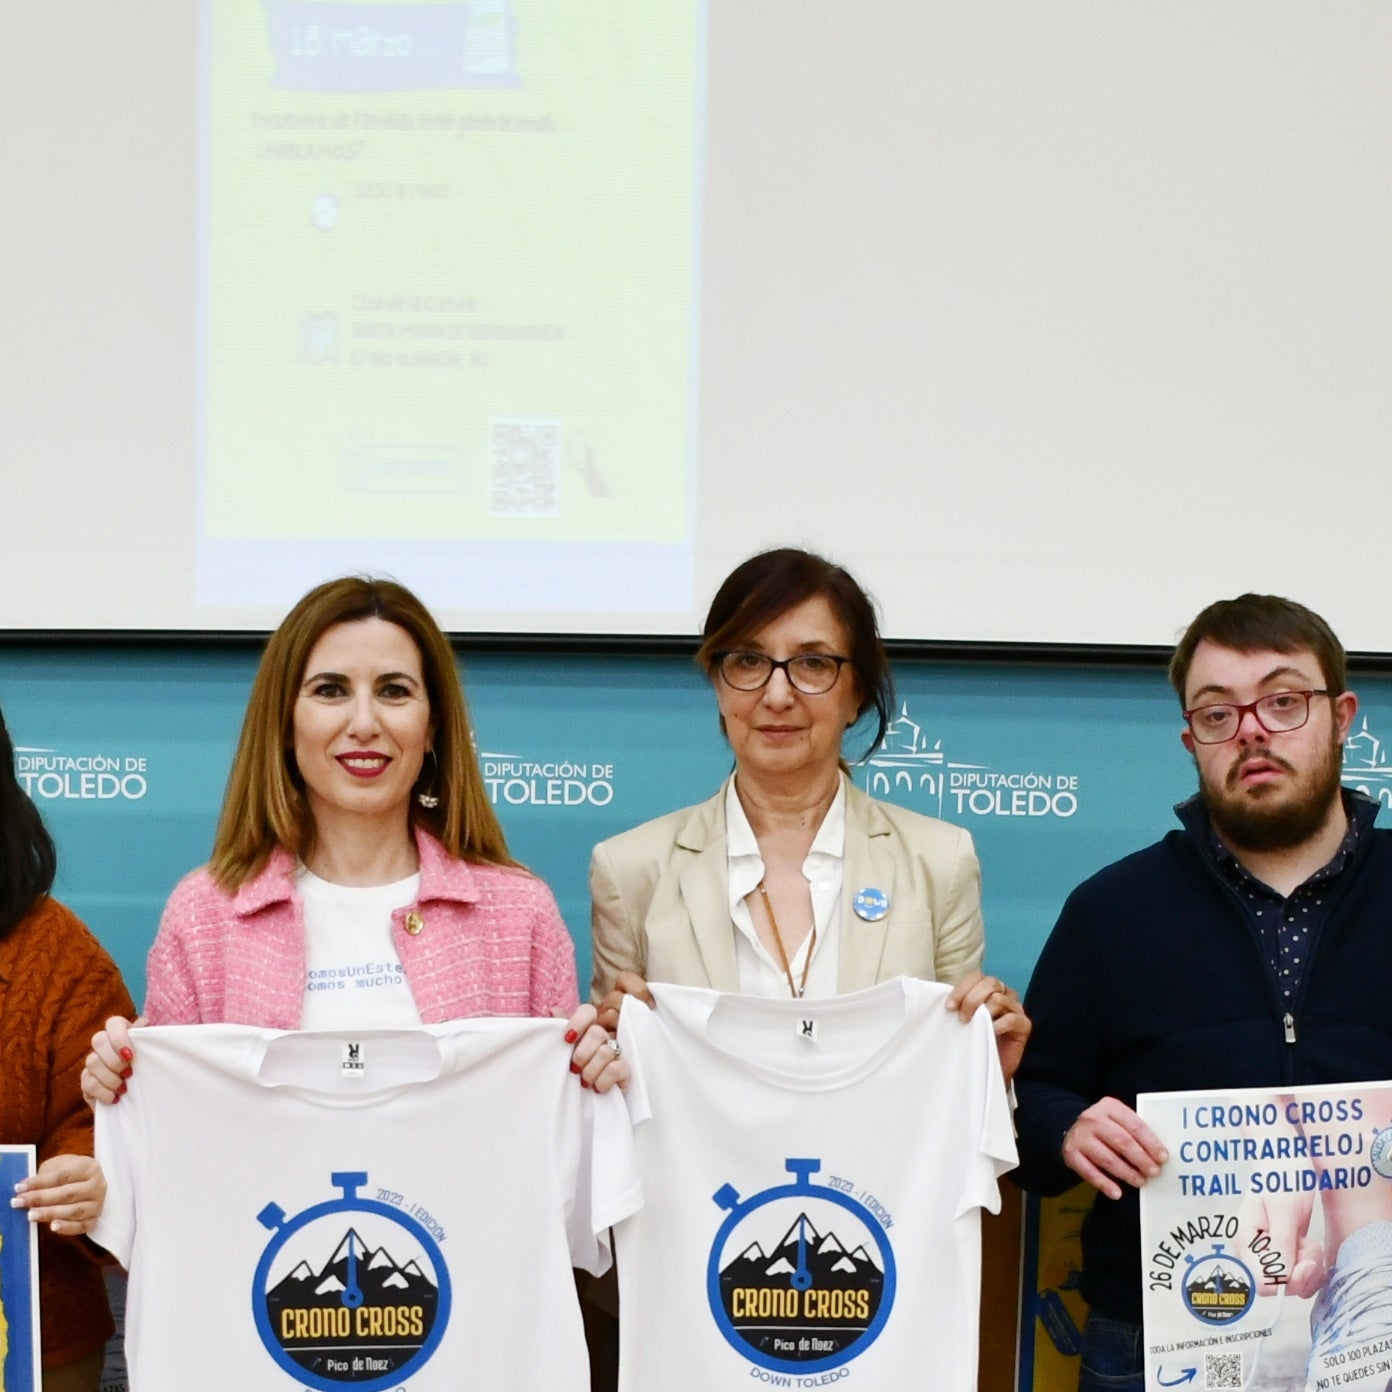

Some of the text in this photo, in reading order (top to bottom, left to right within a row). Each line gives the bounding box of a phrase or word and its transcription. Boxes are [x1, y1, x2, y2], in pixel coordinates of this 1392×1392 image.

[18, 754, 147, 772] DIPUTACIÓN DE
[484, 761, 613, 778] DIPUTACIÓN DE
[18, 772, 147, 799] TOLEDO
[484, 779, 614, 806] TOLEDO
[950, 772, 1078, 790] DIPUTACIÓN DE
[950, 789, 1078, 817] TOLEDO
[307, 963, 406, 979] omosUnEste
[306, 981, 345, 991] omos
[1183, 1098, 1363, 1129] I CRONO CROSS
[1180, 1133, 1363, 1163] CONTRARRELOJ
[828, 1176, 855, 1193] 2023
[1178, 1166, 1371, 1196] TRAIL SOLIDARIO
[376, 1188, 404, 1205] 2023
[1149, 1214, 1239, 1291] 26 DE MARZO
[1248, 1228, 1288, 1286] 10:00H
[732, 1287, 869, 1319] CRONO CROSS
[281, 1305, 424, 1339] CRONO CROSS
[774, 1338, 795, 1351] Pico
[798, 1337, 810, 1351] de
[327, 1359, 349, 1372] Pico
[352, 1357, 364, 1371] de
[1324, 1354, 1345, 1368] SOLO
[1348, 1349, 1361, 1361] 100
[749, 1366, 850, 1389] DOWN TOLEDO
[1332, 1374, 1341, 1386] TE
[1343, 1365, 1375, 1383] QUEDES
[1376, 1361, 1391, 1373] SIN
